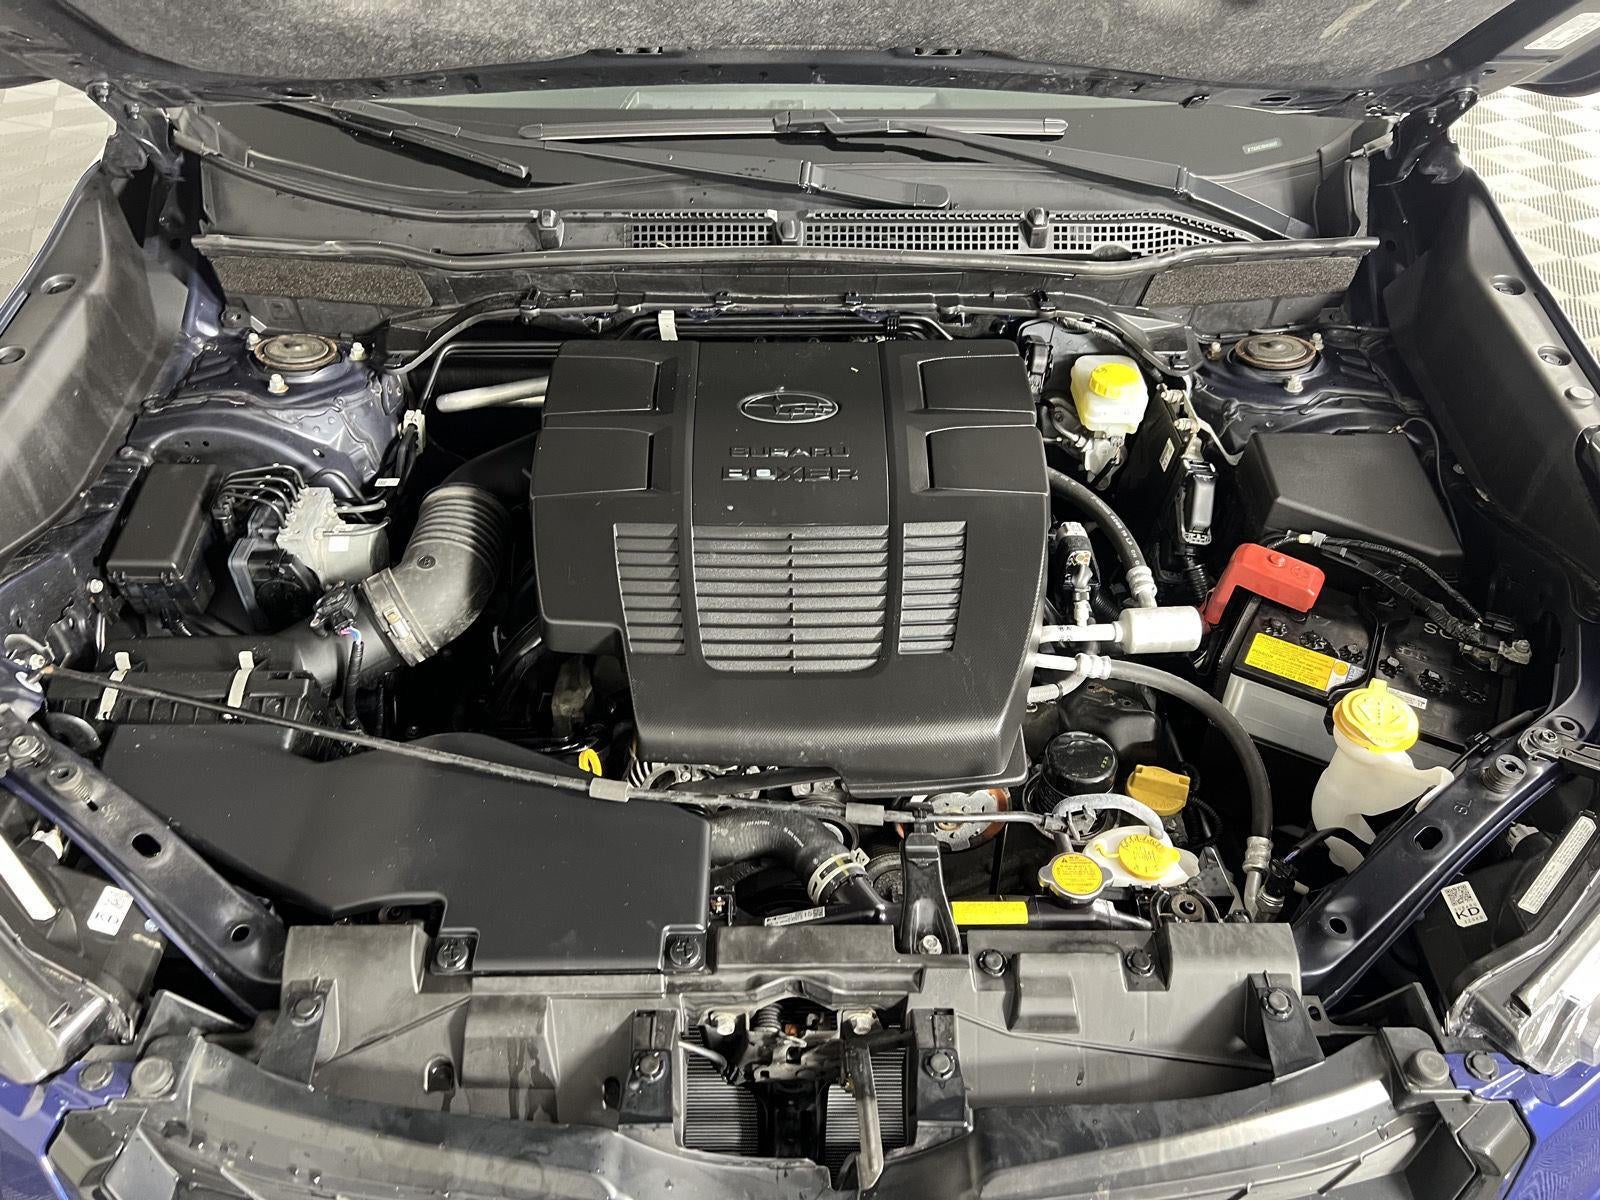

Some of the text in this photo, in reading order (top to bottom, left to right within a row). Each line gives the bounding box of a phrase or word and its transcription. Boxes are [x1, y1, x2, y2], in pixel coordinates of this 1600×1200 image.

[729, 446, 850, 458] SUBARU
[721, 466, 860, 482] BOXER
[1455, 906, 1480, 920] KD
